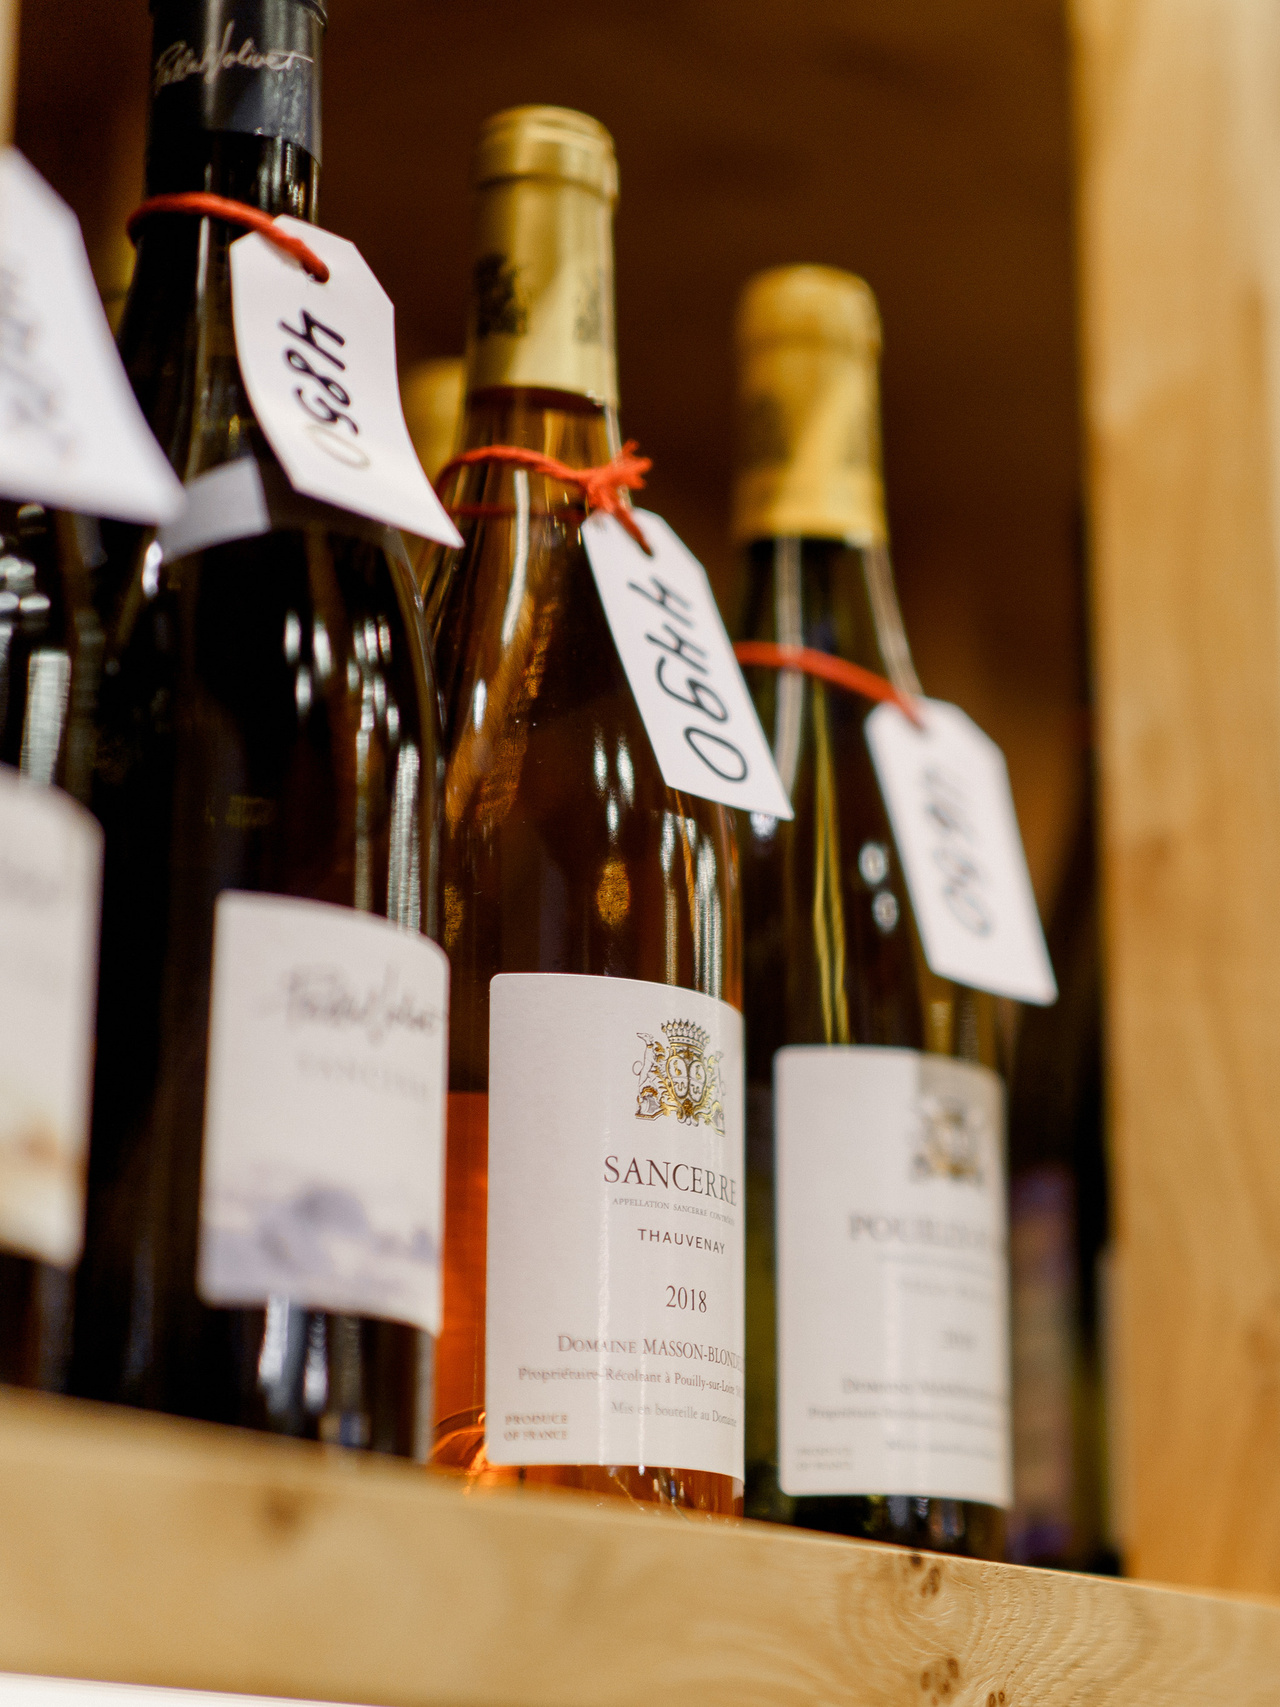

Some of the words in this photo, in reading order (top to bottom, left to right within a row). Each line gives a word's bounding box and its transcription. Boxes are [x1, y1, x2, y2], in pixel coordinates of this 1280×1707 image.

[279, 309, 371, 470] 4850
[628, 575, 749, 782] 4490
[603, 1154, 738, 1207] SANCERRE
[611, 1197, 670, 1210] APPELLATION
[672, 1203, 708, 1217] SANCERRE
[637, 1228, 725, 1255] THAUVENAY
[665, 1285, 708, 1314] 2018
[664, 1371, 671, 1384] à
[504, 1413, 568, 1426] PRODUCE
[610, 1401, 634, 1415] Mis
[637, 1405, 651, 1416] en
[655, 1402, 698, 1420] bouteille
[700, 1410, 710, 1421] au
[503, 1430, 519, 1442] OF
[522, 1430, 568, 1441] FRANCE
